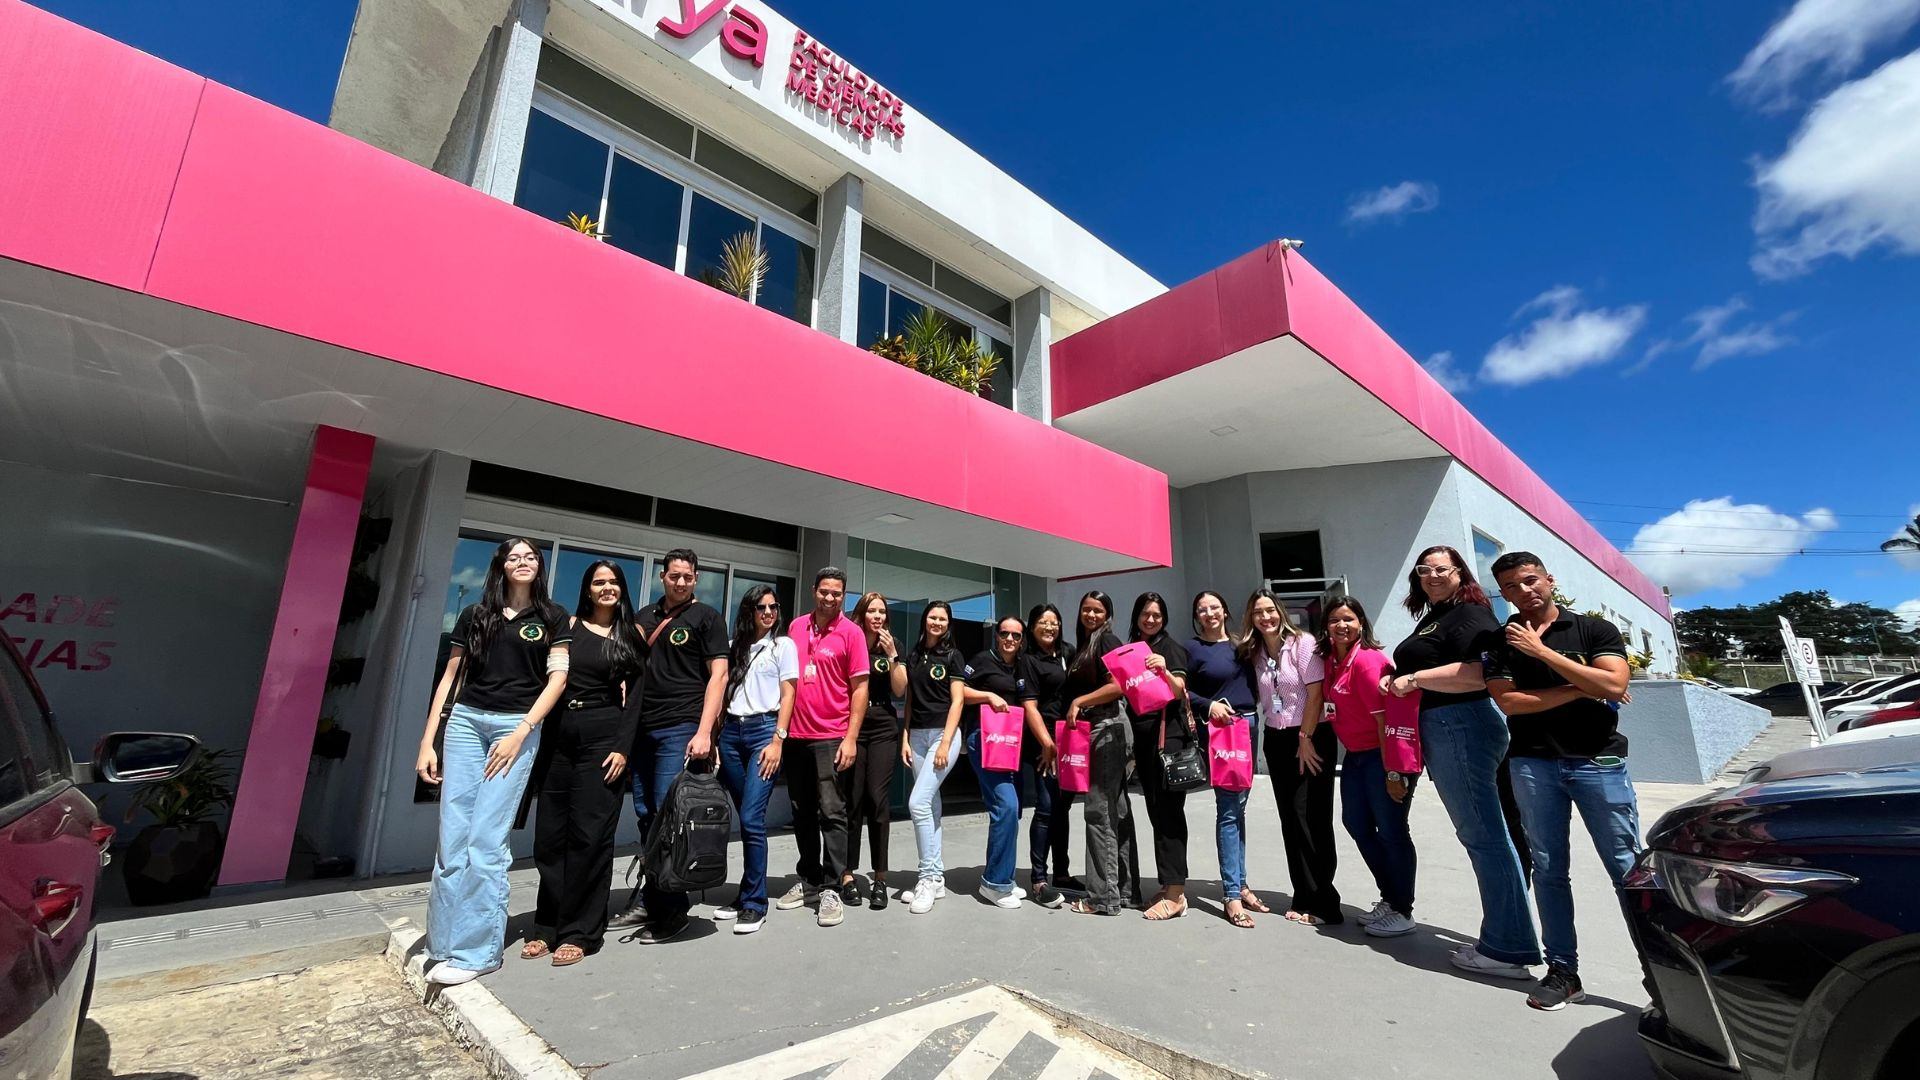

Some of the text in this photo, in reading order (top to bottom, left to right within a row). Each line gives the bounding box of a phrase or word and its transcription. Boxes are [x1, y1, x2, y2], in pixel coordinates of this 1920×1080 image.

[656, 0, 768, 68] ya
[790, 50, 818, 81] DE
[794, 29, 903, 117] FACULDADE
[0, 592, 119, 628] ADE
[986, 732, 1005, 744] Afya
[1384, 724, 1396, 737] fya
[1214, 749, 1236, 760] Afya
